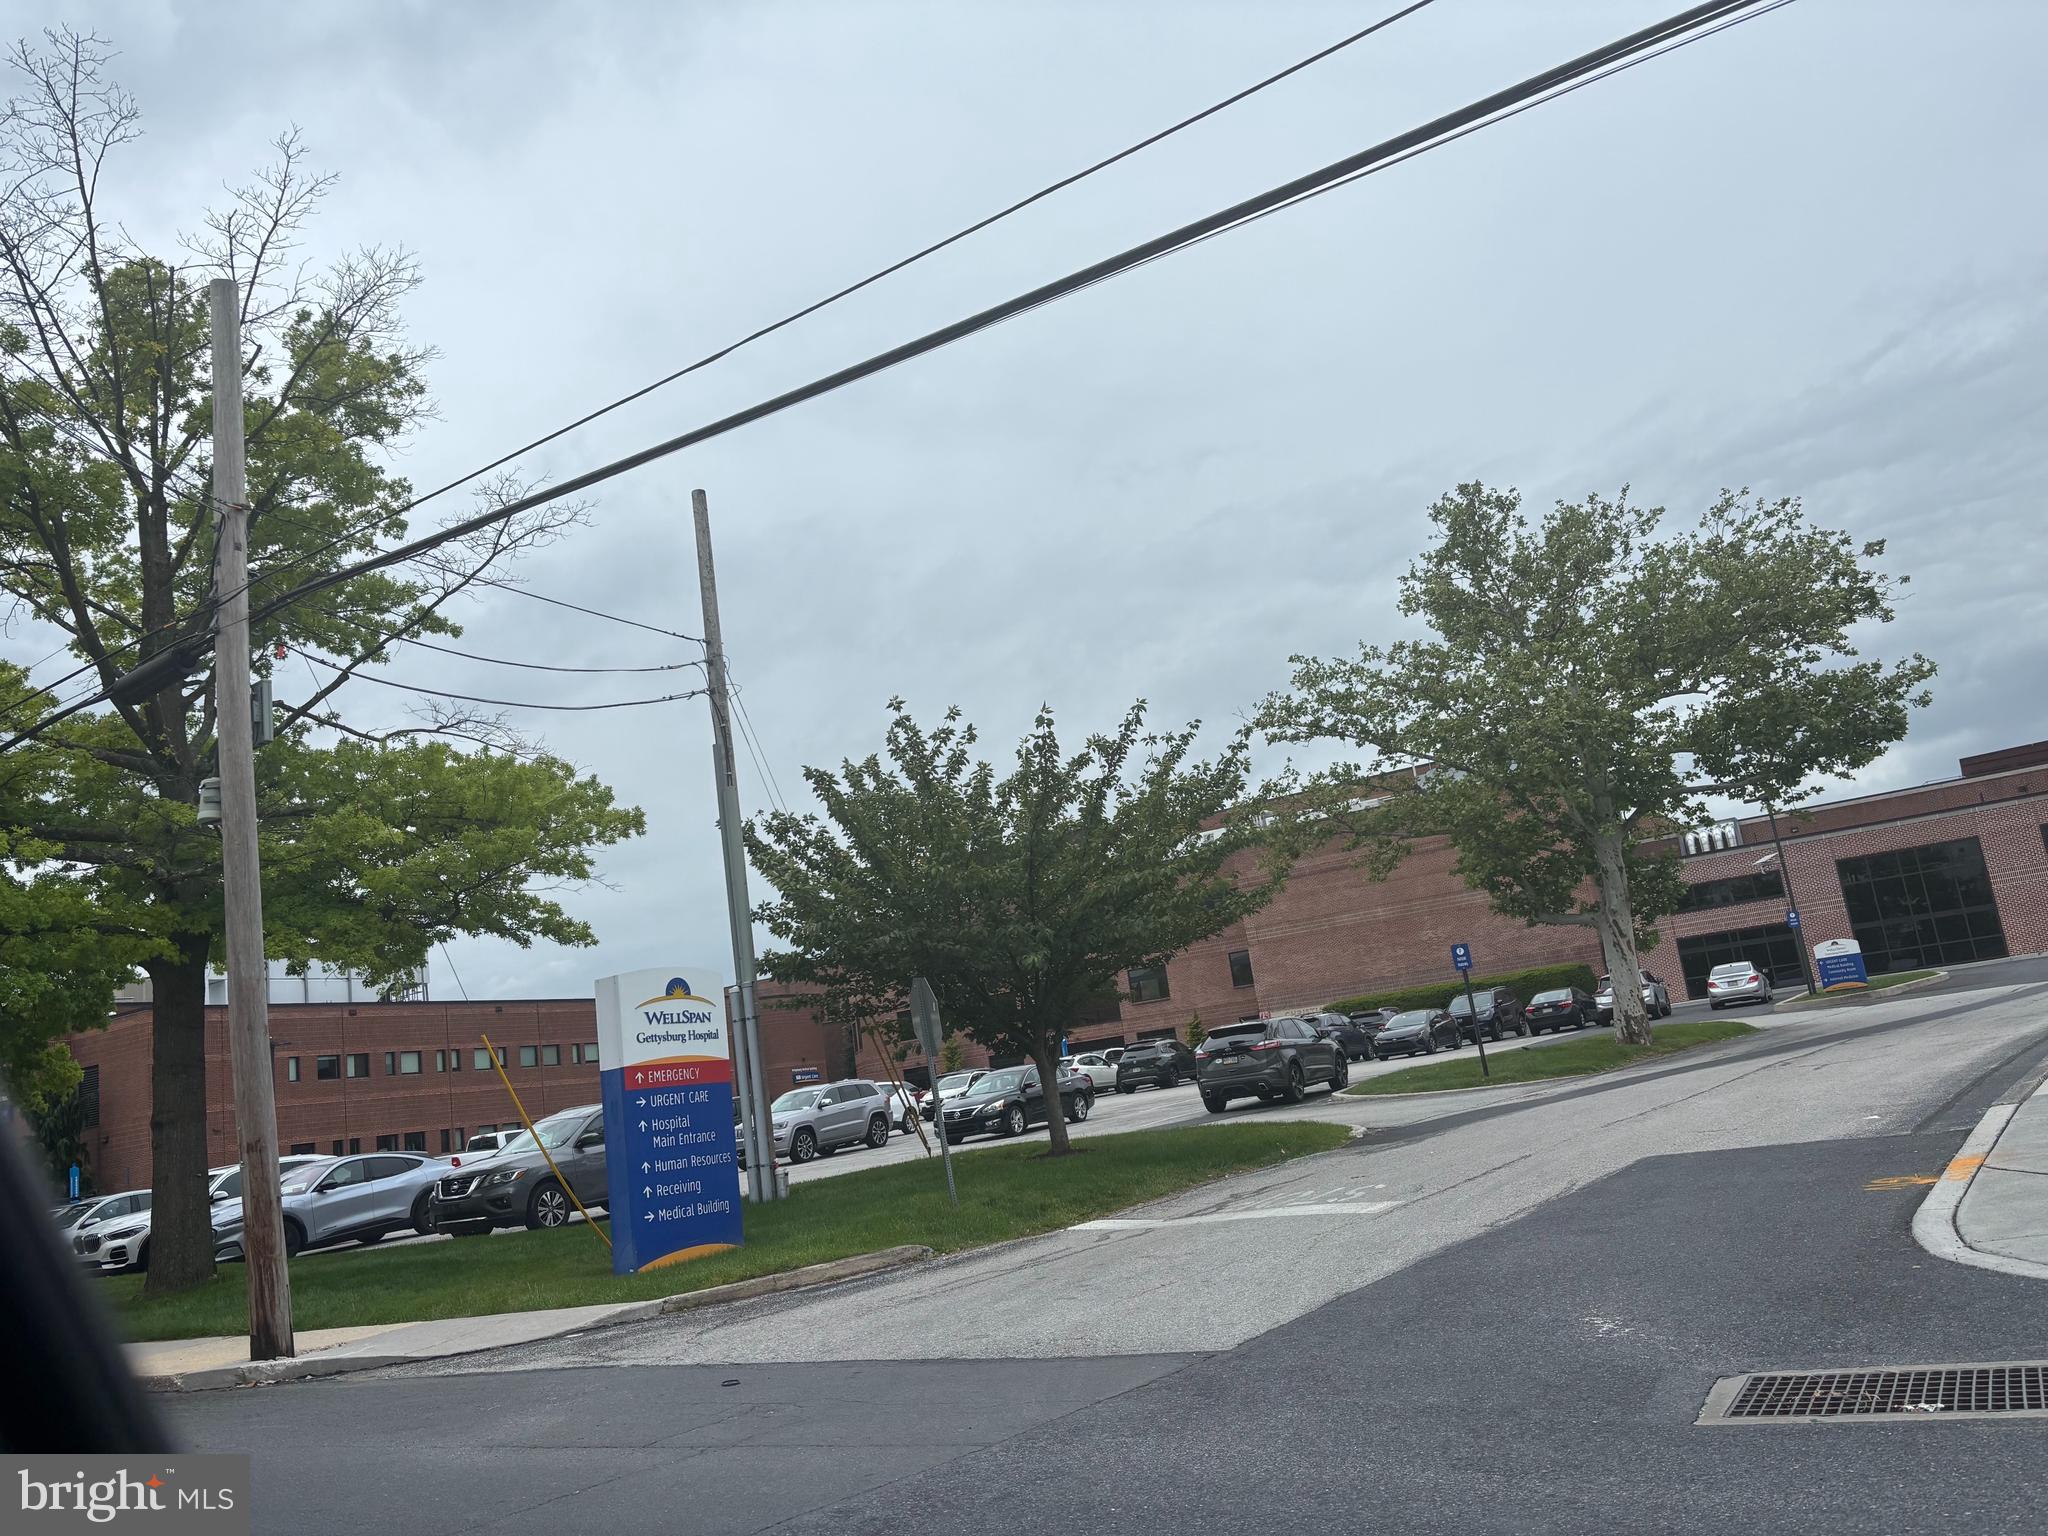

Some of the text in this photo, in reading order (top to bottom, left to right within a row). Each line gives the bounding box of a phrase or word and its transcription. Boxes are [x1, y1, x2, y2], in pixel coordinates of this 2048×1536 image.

[636, 1028, 719, 1045] Gettysburg Hospital
[648, 1067, 700, 1083] EMERGENCY
[650, 1090, 709, 1108] URGENT CARE
[652, 1115, 690, 1132] Hospital
[653, 1130, 716, 1149] Main Entrance
[655, 1152, 731, 1173] Human Resources
[656, 1179, 701, 1197] Receiving
[658, 1199, 730, 1222] Medical Building
